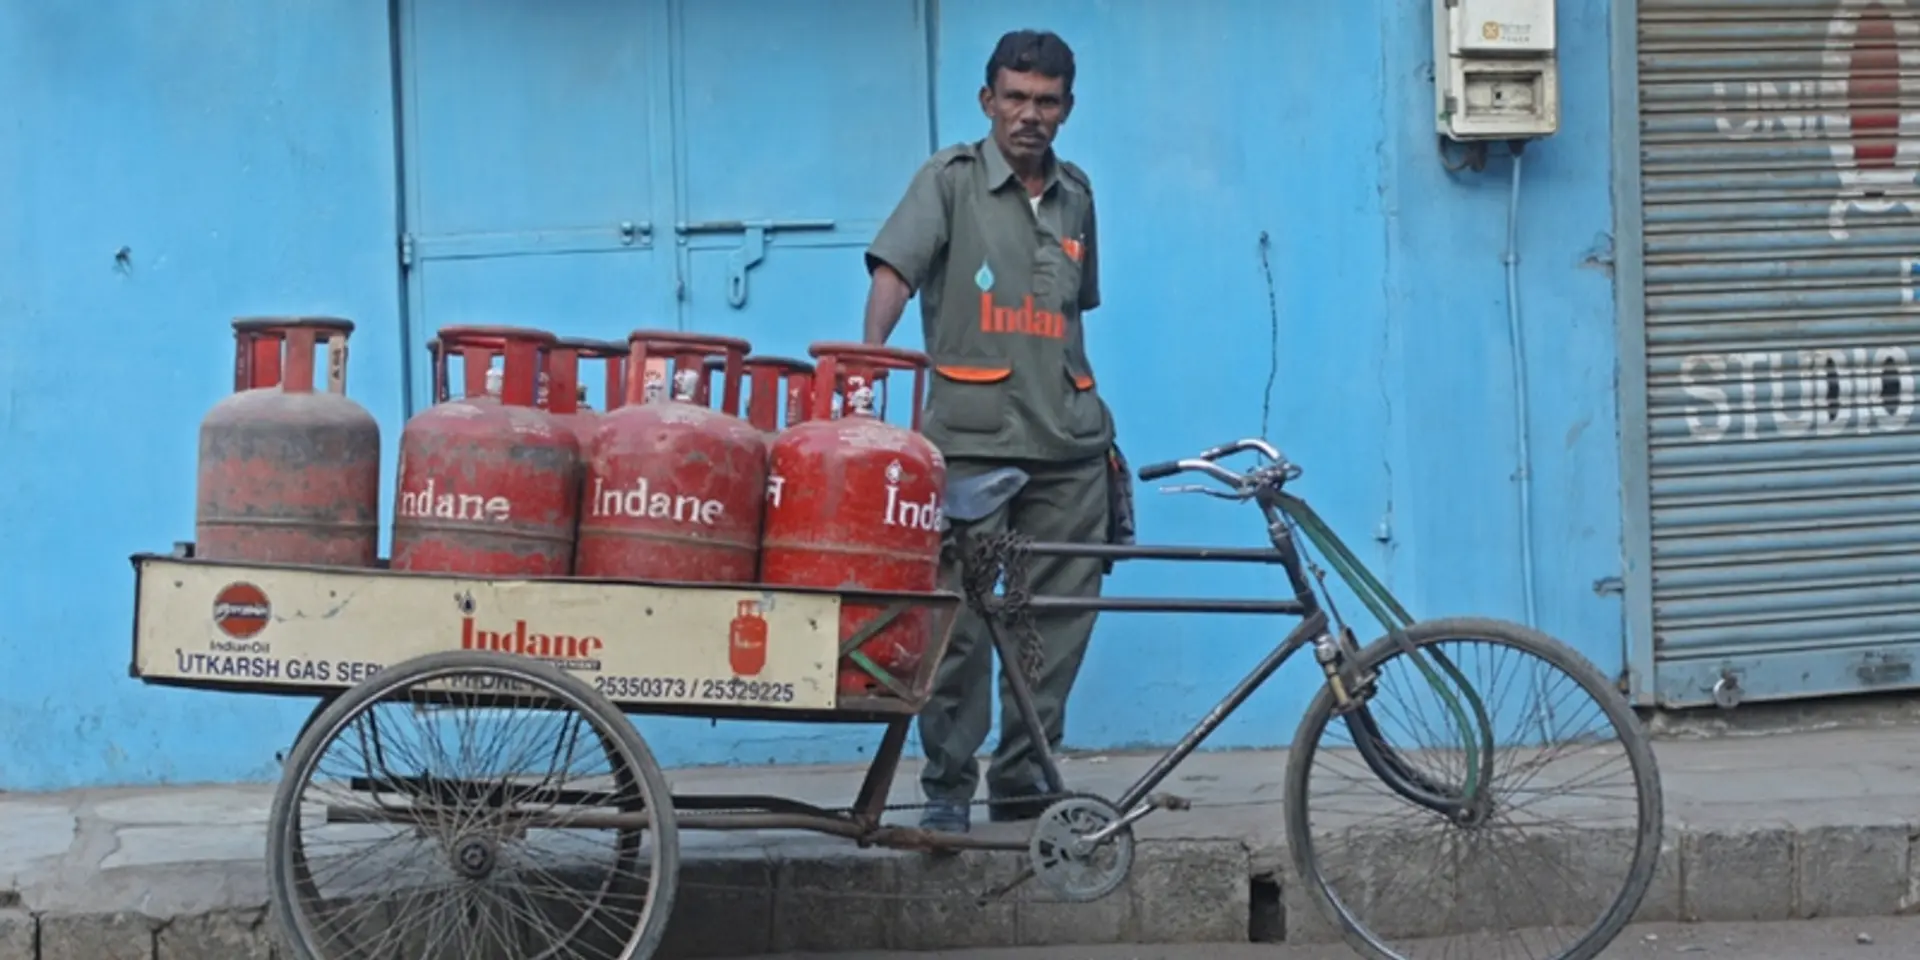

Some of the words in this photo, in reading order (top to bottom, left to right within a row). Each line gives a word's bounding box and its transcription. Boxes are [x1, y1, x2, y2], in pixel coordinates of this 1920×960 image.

[1680, 346, 1915, 440] STUDIO
[400, 478, 510, 520] ndane
[592, 477, 724, 524] Indane
[462, 617, 603, 657] Indane
[177, 652, 280, 677] UTKARSH
[285, 659, 330, 680] GAS
[336, 661, 384, 682] SER
[595, 676, 686, 697] 25350373
[702, 680, 795, 702] 25329225
